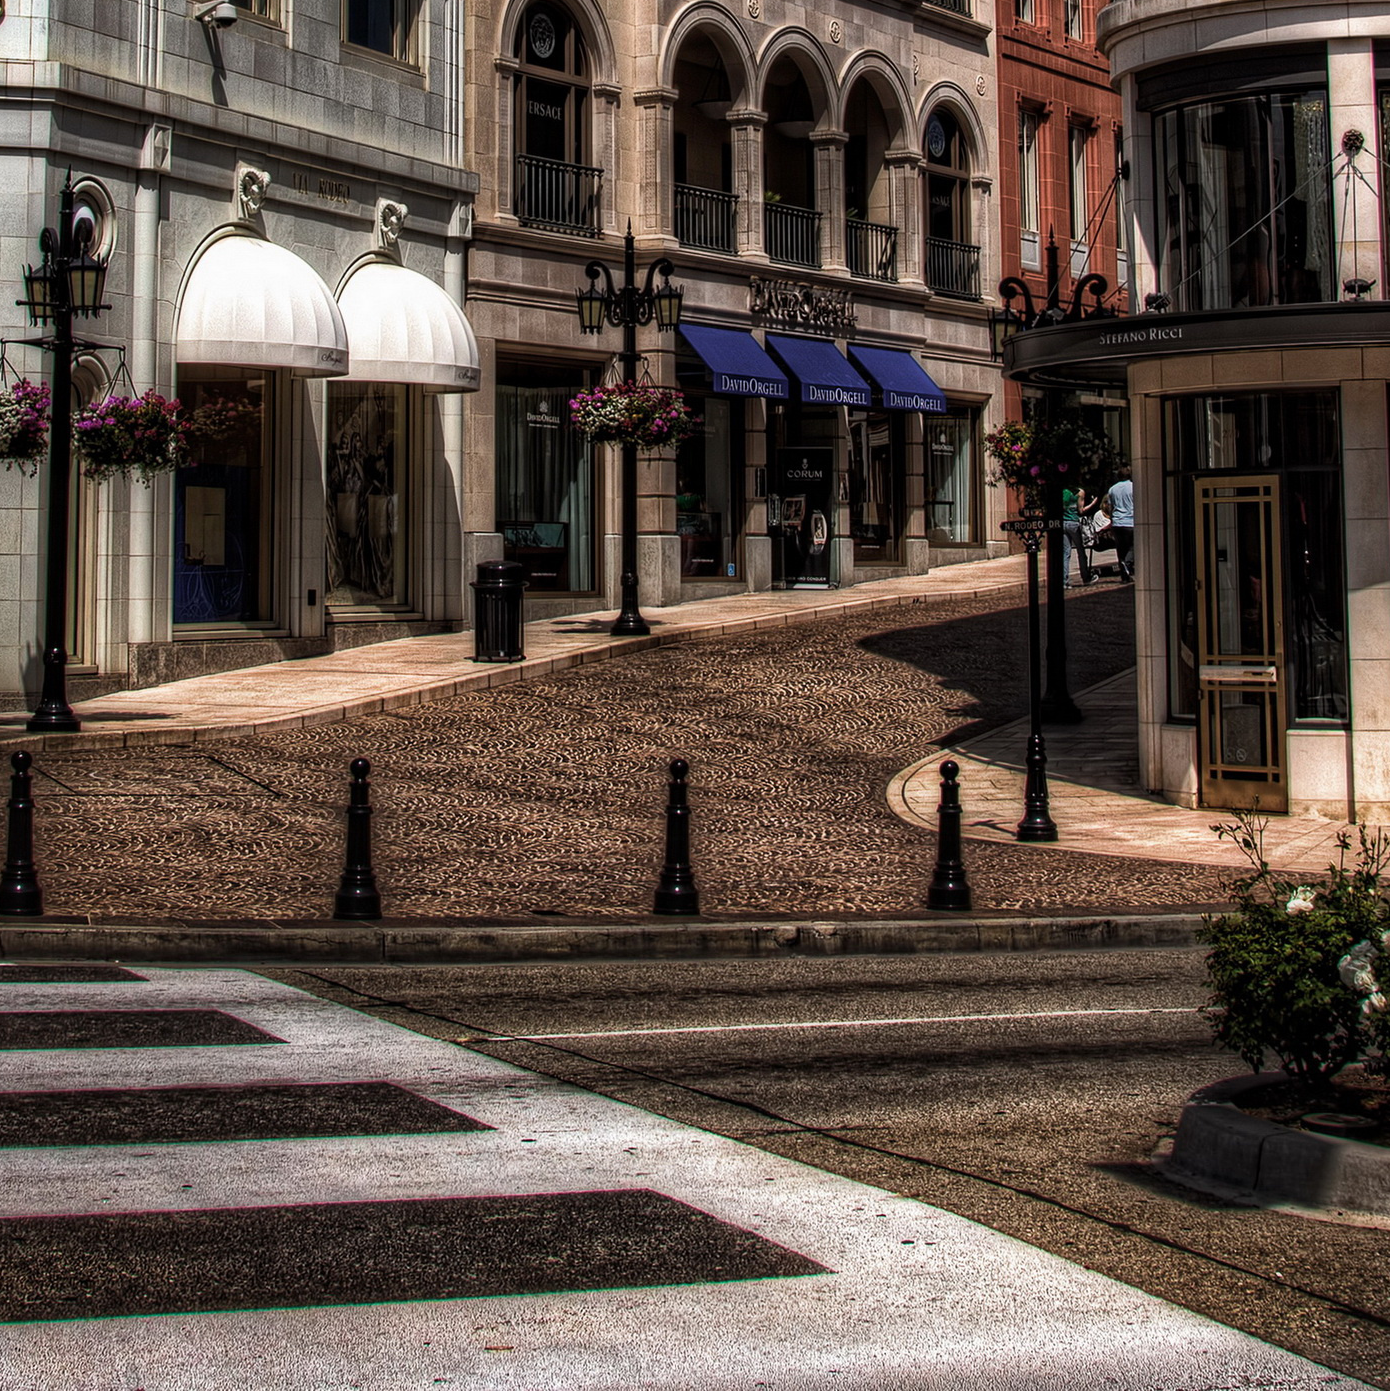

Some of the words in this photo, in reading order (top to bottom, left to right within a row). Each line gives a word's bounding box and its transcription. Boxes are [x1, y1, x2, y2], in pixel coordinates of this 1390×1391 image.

[527, 100, 561, 121] ERSACE
[1099, 331, 1146, 345] STEFANO
[1149, 328, 1182, 340] RICCI
[786, 469, 823, 479] CORUM
[1014, 520, 1044, 530] RODEO
[1048, 519, 1061, 529] DR
